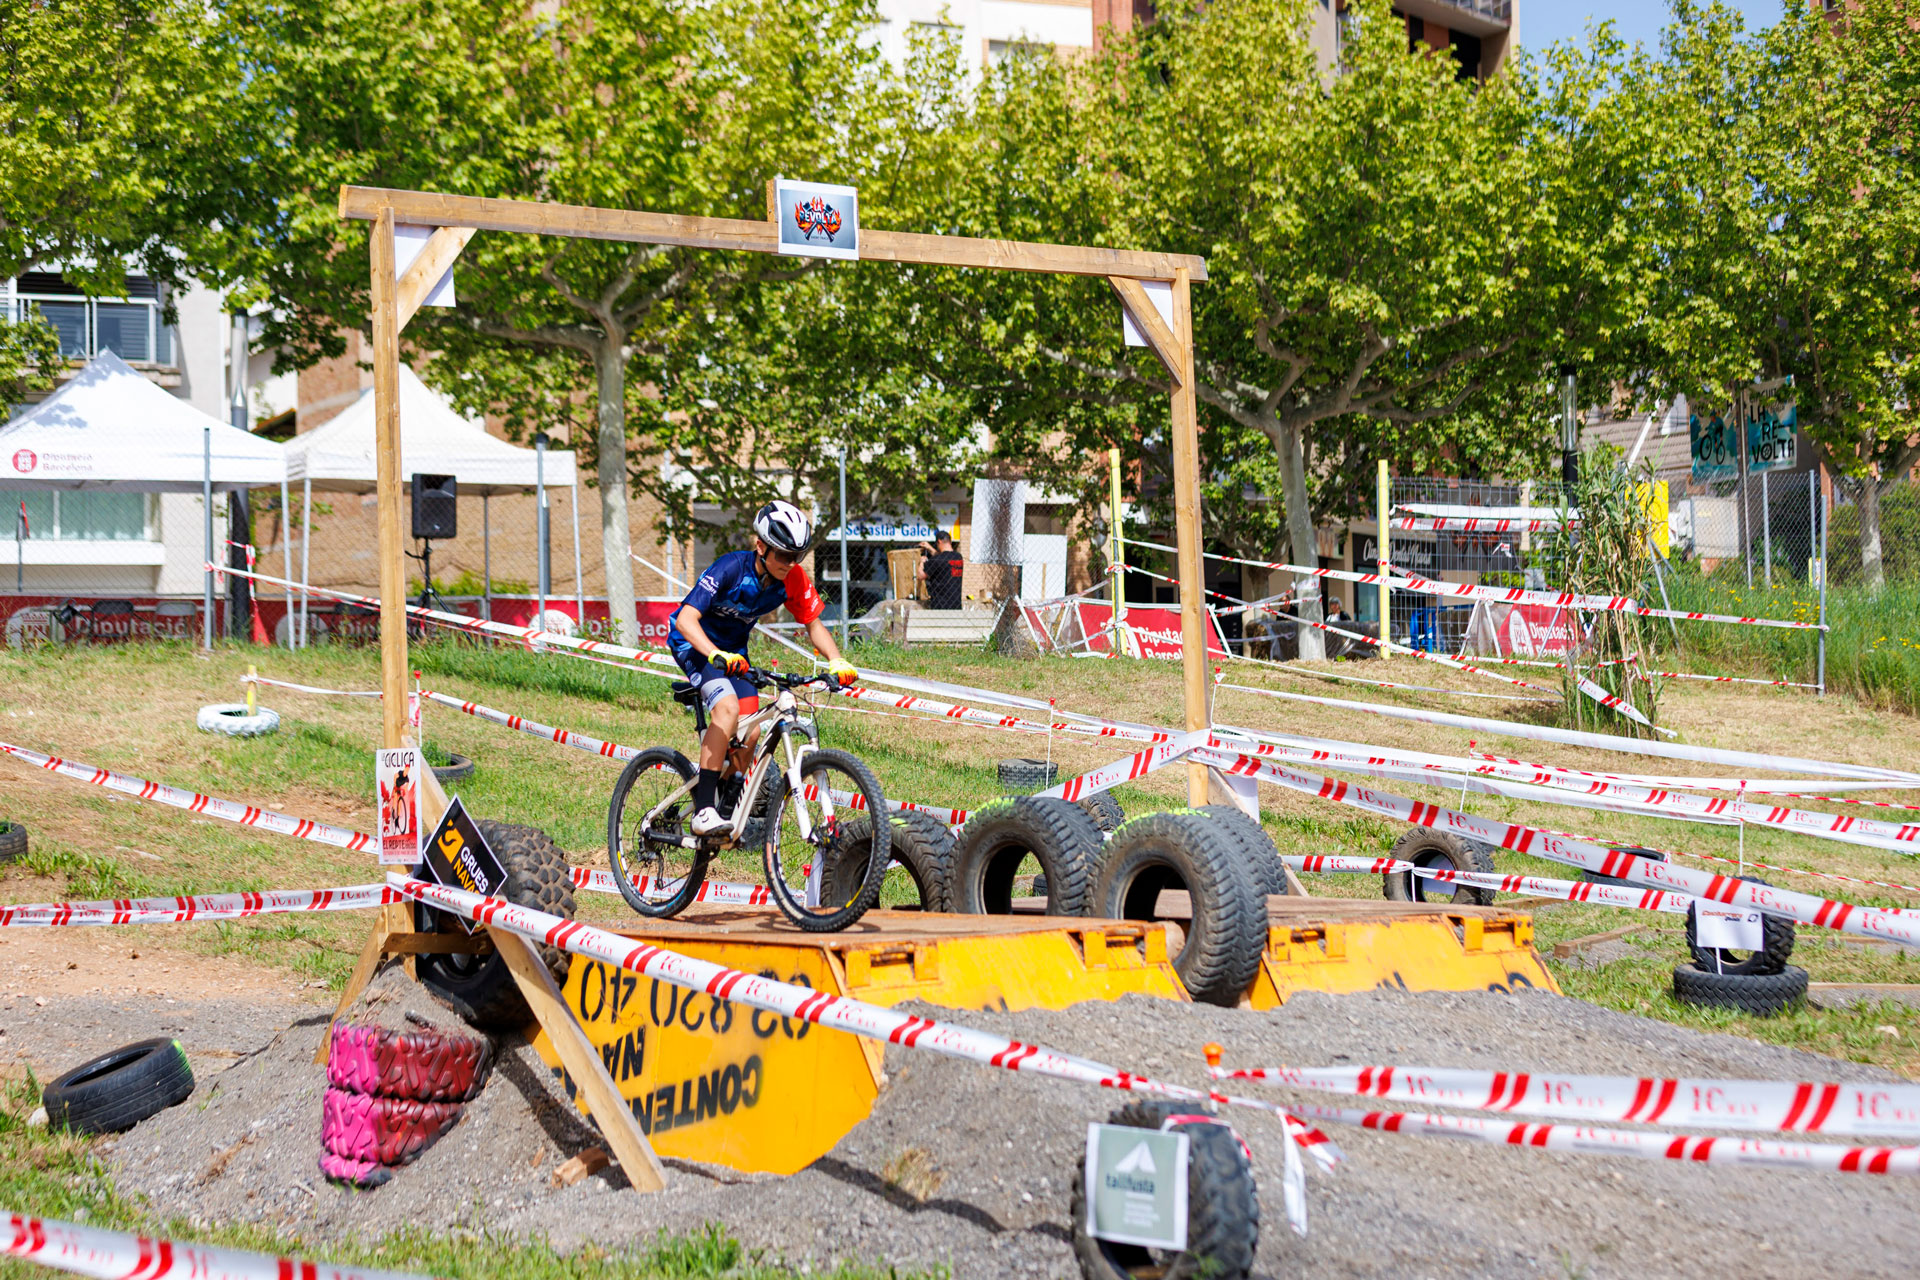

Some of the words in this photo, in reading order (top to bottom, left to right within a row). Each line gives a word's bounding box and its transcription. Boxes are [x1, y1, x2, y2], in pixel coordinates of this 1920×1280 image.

[799, 211, 838, 225] REVOLTA
[1751, 438, 1795, 465] VOLTA
[1136, 626, 1184, 647] Diputac
[384, 751, 415, 768] CICLICA
[460, 846, 489, 893] GRUES
[625, 1054, 764, 1137] CONTEN
